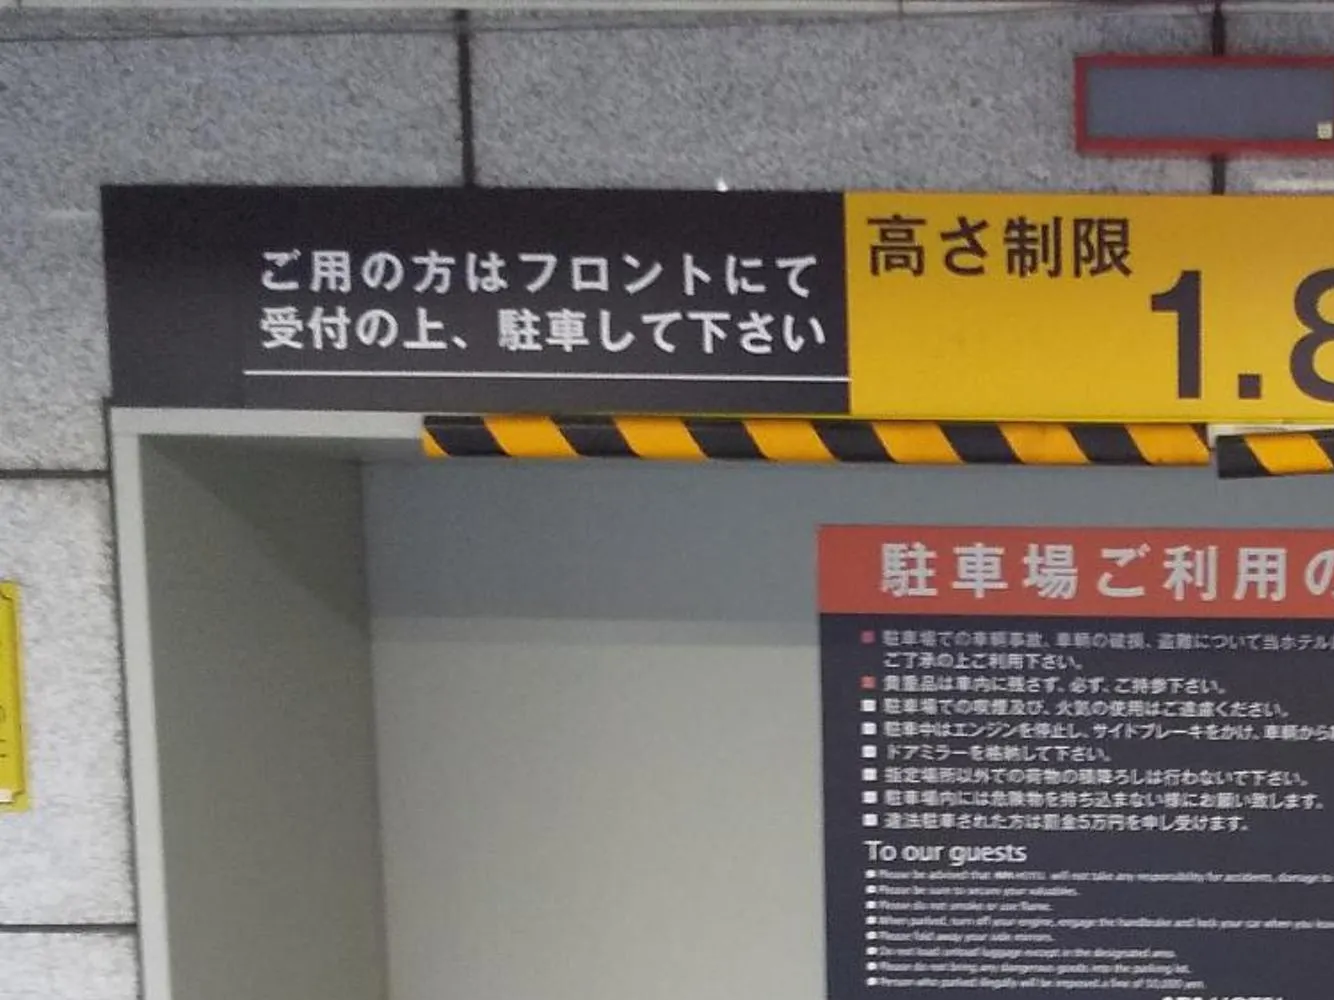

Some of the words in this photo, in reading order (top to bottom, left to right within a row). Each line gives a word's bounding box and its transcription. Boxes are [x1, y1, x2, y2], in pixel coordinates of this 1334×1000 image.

[866, 213, 1134, 279] 高さ制限
[261, 248, 818, 296] ご用の方はフロントにて
[260, 306, 826, 354] 受付の上、駐車して下さい
[863, 839, 898, 862] To
[900, 845, 945, 862] our
[948, 843, 1028, 867] guests
